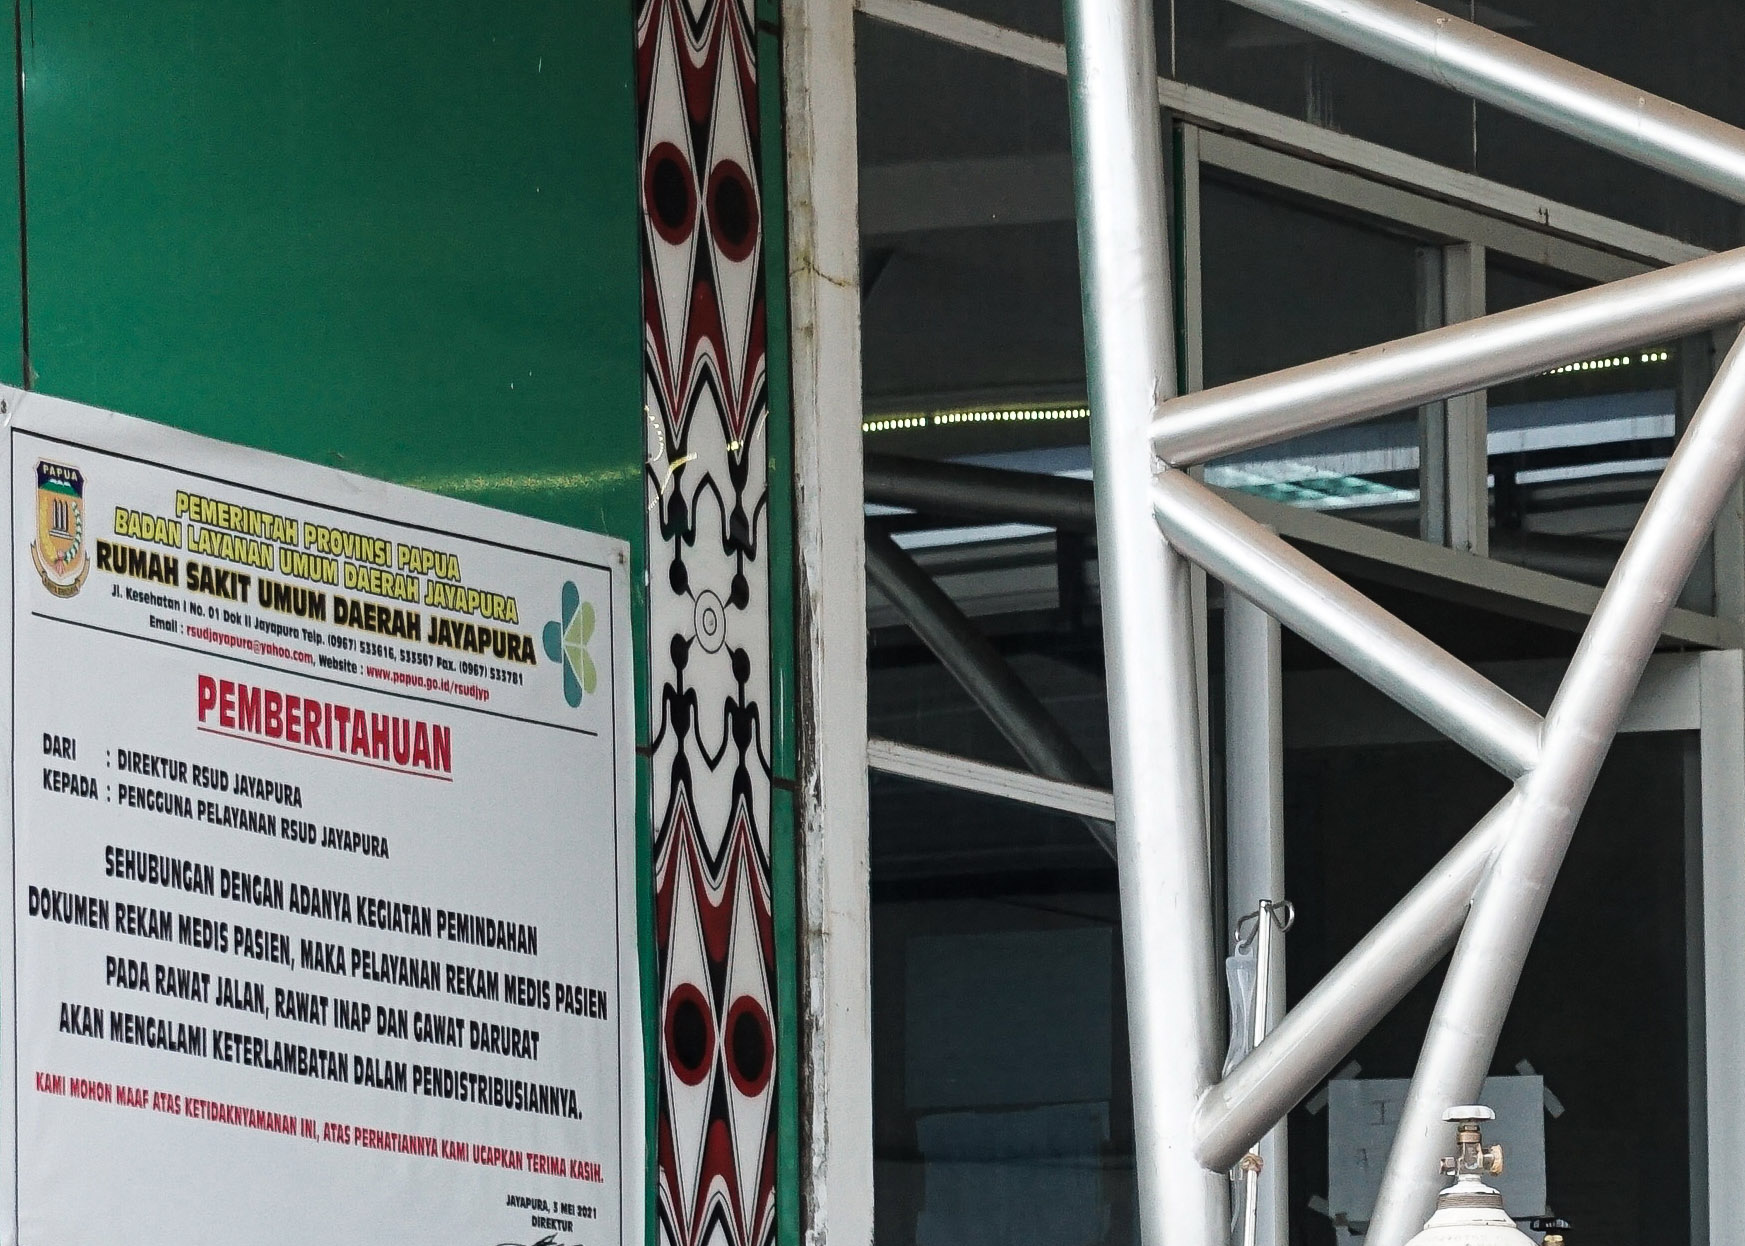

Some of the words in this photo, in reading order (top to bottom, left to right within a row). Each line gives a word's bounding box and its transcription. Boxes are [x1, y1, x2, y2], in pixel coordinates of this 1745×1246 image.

[42, 464, 78, 482] PAPUA
[113, 507, 183, 550] BADAN
[186, 523, 275, 570] LAYANAN
[278, 544, 340, 584] UMUM
[343, 558, 421, 602] DAERAH
[423, 576, 520, 624] JAYAPURA
[174, 491, 300, 546] PEMERINTAH
[303, 520, 393, 567] PROVINSI
[396, 541, 461, 582] PAPUA
[95, 541, 180, 588] RUMAH
[185, 560, 252, 604] SAKIT
[257, 575, 327, 620] UMUM
[332, 591, 422, 640] DAERAH
[427, 611, 537, 665] JAYAPURA
[111, 584, 123, 602] Jl.
[125, 587, 181, 614] Kesehatan
[187, 600, 206, 619] No.
[207, 605, 220, 622] 01
[220, 607, 242, 627] Dok
[253, 614, 300, 639] Jayapura
[300, 624, 326, 645] Telp.
[327, 630, 358, 652] (0967)
[358, 637, 398, 660] 533616,
[399, 645, 434, 668] 533567
[435, 653, 458, 673] Fax.
[458, 658, 488, 679] (0967)
[489, 664, 525, 687] 533781
[149, 615, 178, 636] Email
[186, 623, 316, 665] rsudjayapura@yahoo.com,
[318, 650, 358, 674] Website
[366, 660, 490, 702] www.papua.go.id/rsudjyp
[42, 732, 77, 761] DARI
[117, 748, 188, 784] DIREKTUR
[192, 763, 229, 793] RSUD
[232, 772, 303, 808] JAYAPURA
[197, 675, 452, 772] PEMBERITAHUAN
[42, 768, 99, 800] KEPADA
[117, 783, 193, 819] PENGGUNA
[196, 799, 277, 836] PELAYANAN
[280, 816, 317, 844] RSUD
[320, 824, 390, 859] JAYAPURA
[104, 845, 215, 896] SEHUBUNGAN
[218, 867, 285, 909] DENGAN
[287, 880, 353, 921] ADANYA
[356, 892, 432, 936] KEGIATAN
[436, 907, 538, 956] PEMINDAHAN
[28, 885, 110, 931] DOKUMEN
[114, 901, 173, 942] REKAM
[178, 913, 229, 952] MEDIS
[233, 923, 295, 964] PASIEN,
[300, 935, 346, 974] MAKA
[350, 944, 441, 991] PELAYANAN
[445, 961, 500, 1001] REKAM
[504, 972, 551, 1011] MEDIS
[555, 981, 608, 1021] PASIEN
[105, 955, 150, 992] PADA
[154, 964, 211, 1003] RAWAT
[215, 974, 269, 1017] JALAN,
[274, 985, 329, 1024] RAWAT
[333, 995, 372, 1031] INAP
[376, 1002, 409, 1038] DAN
[413, 1009, 465, 1048] GAWAT
[469, 1018, 540, 1061] DARURAT
[58, 1002, 105, 1040] AKAN
[109, 1011, 208, 1057] MENGALAMI
[212, 1028, 349, 1081] KETERLAMBATAN
[353, 1051, 408, 1090] DALAM
[412, 1060, 583, 1120] PENDISTRIBUSIANNYA.
[35, 1071, 66, 1097] KAMI
[69, 1077, 113, 1105] MOHON
[115, 1084, 149, 1110] MAAF
[152, 1090, 182, 1116] ATAS
[184, 1095, 298, 1134] KETIDAKNYAMANAN
[300, 1113, 317, 1140] INI,
[323, 1117, 351, 1143] ATAS
[353, 1122, 439, 1157] PERHATIANNYA
[441, 1136, 470, 1162] KAMI
[472, 1141, 524, 1171] UCAPKAN
[526, 1149, 567, 1178] TERIMA
[569, 1156, 604, 1184] KASIH.
[505, 1194, 551, 1212] JAYAPURA,
[560, 1202, 576, 1216] MEI
[576, 1205, 597, 1219] 2021
[530, 1215, 574, 1232] DIREKTUR
